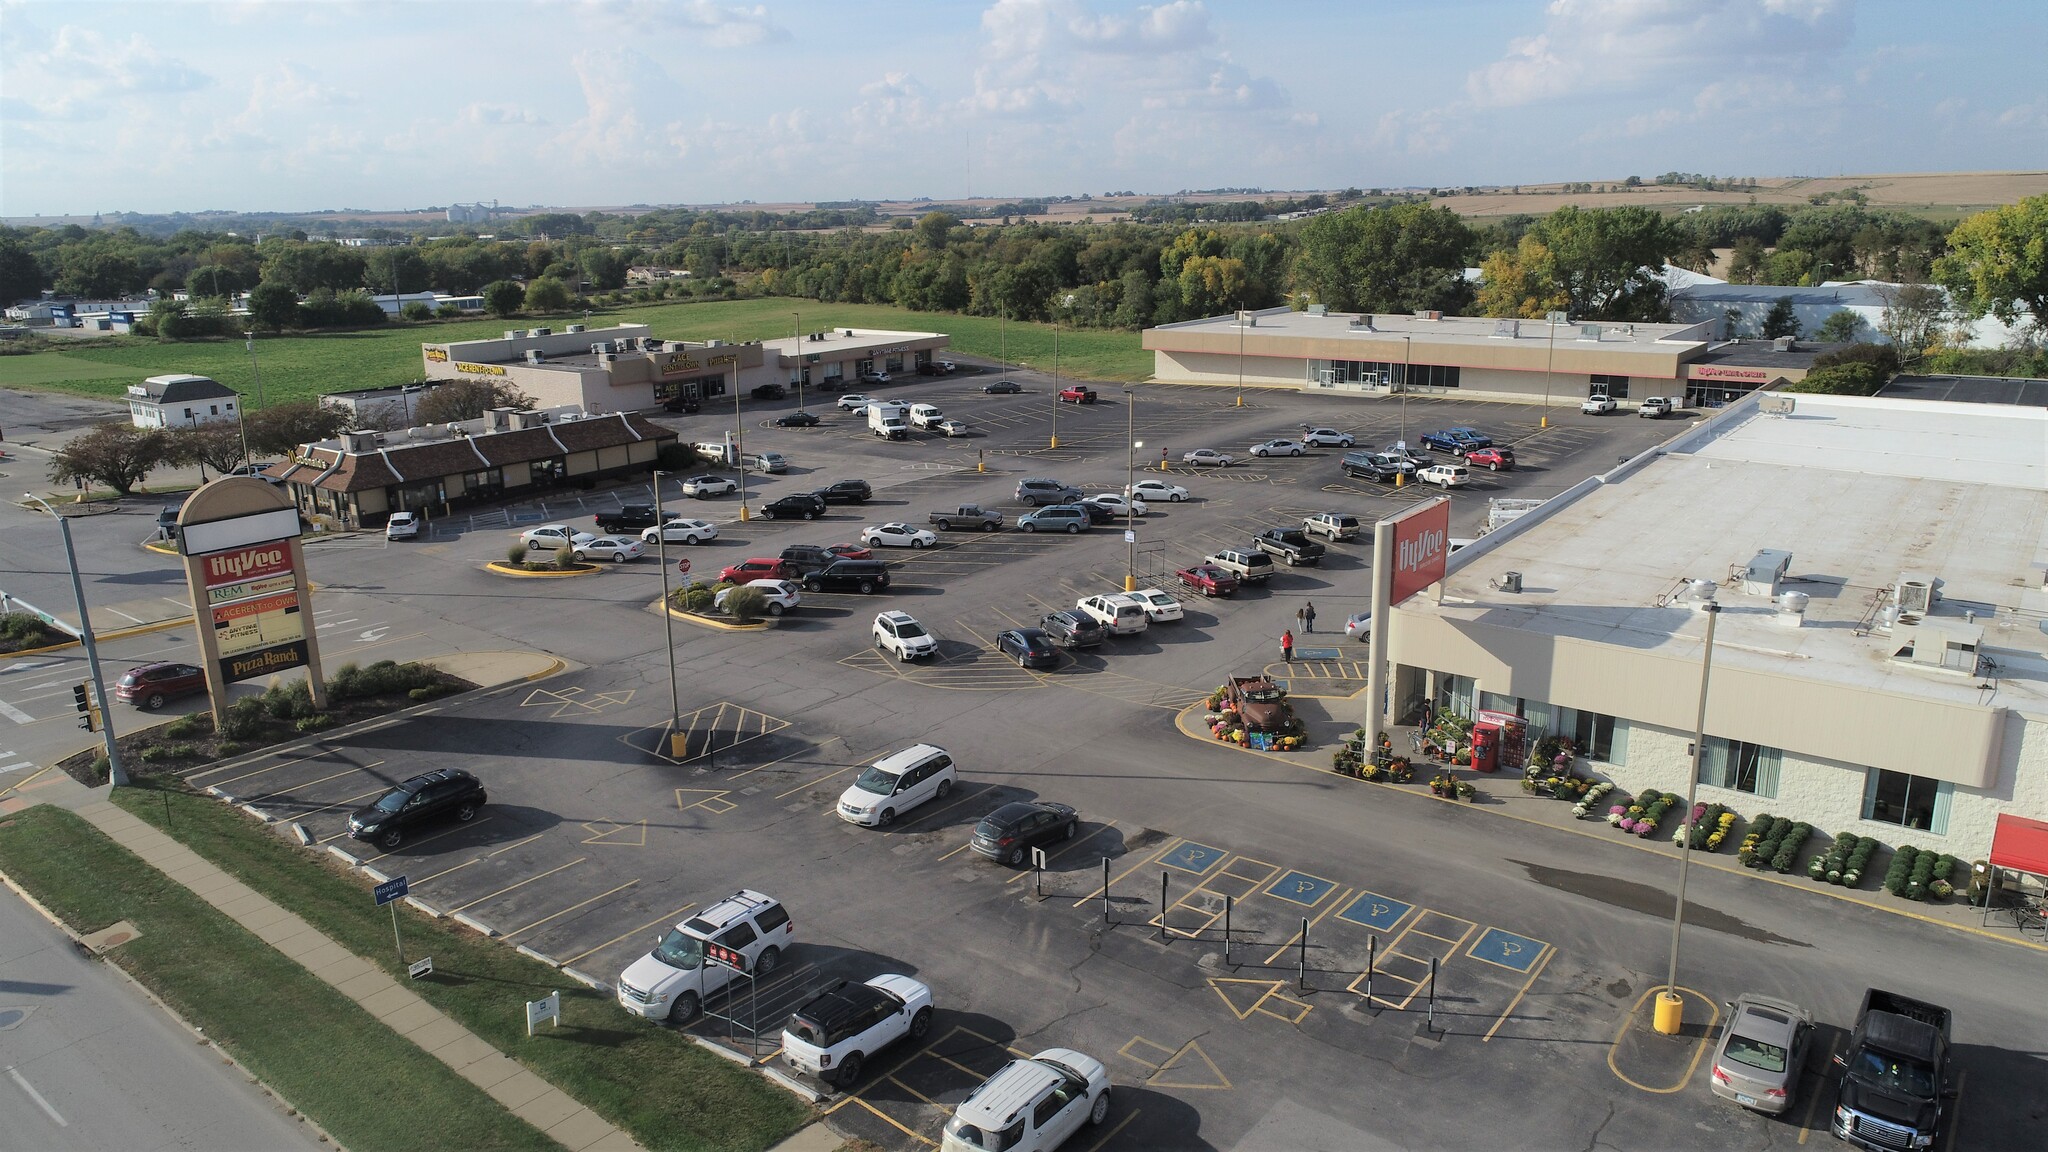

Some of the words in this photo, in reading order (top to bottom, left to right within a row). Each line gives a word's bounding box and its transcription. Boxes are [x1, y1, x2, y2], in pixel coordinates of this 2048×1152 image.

[676, 353, 690, 362] ACE
[665, 384, 678, 392] ACE
[679, 562, 690, 570] STOP
[213, 585, 243, 599] REM
[229, 623, 257, 634] ANYTIME
[230, 628, 259, 639] FITNESS
[232, 657, 264, 676] Pizza
[264, 648, 298, 666] Ranch
[376, 879, 406, 896] Hospital
